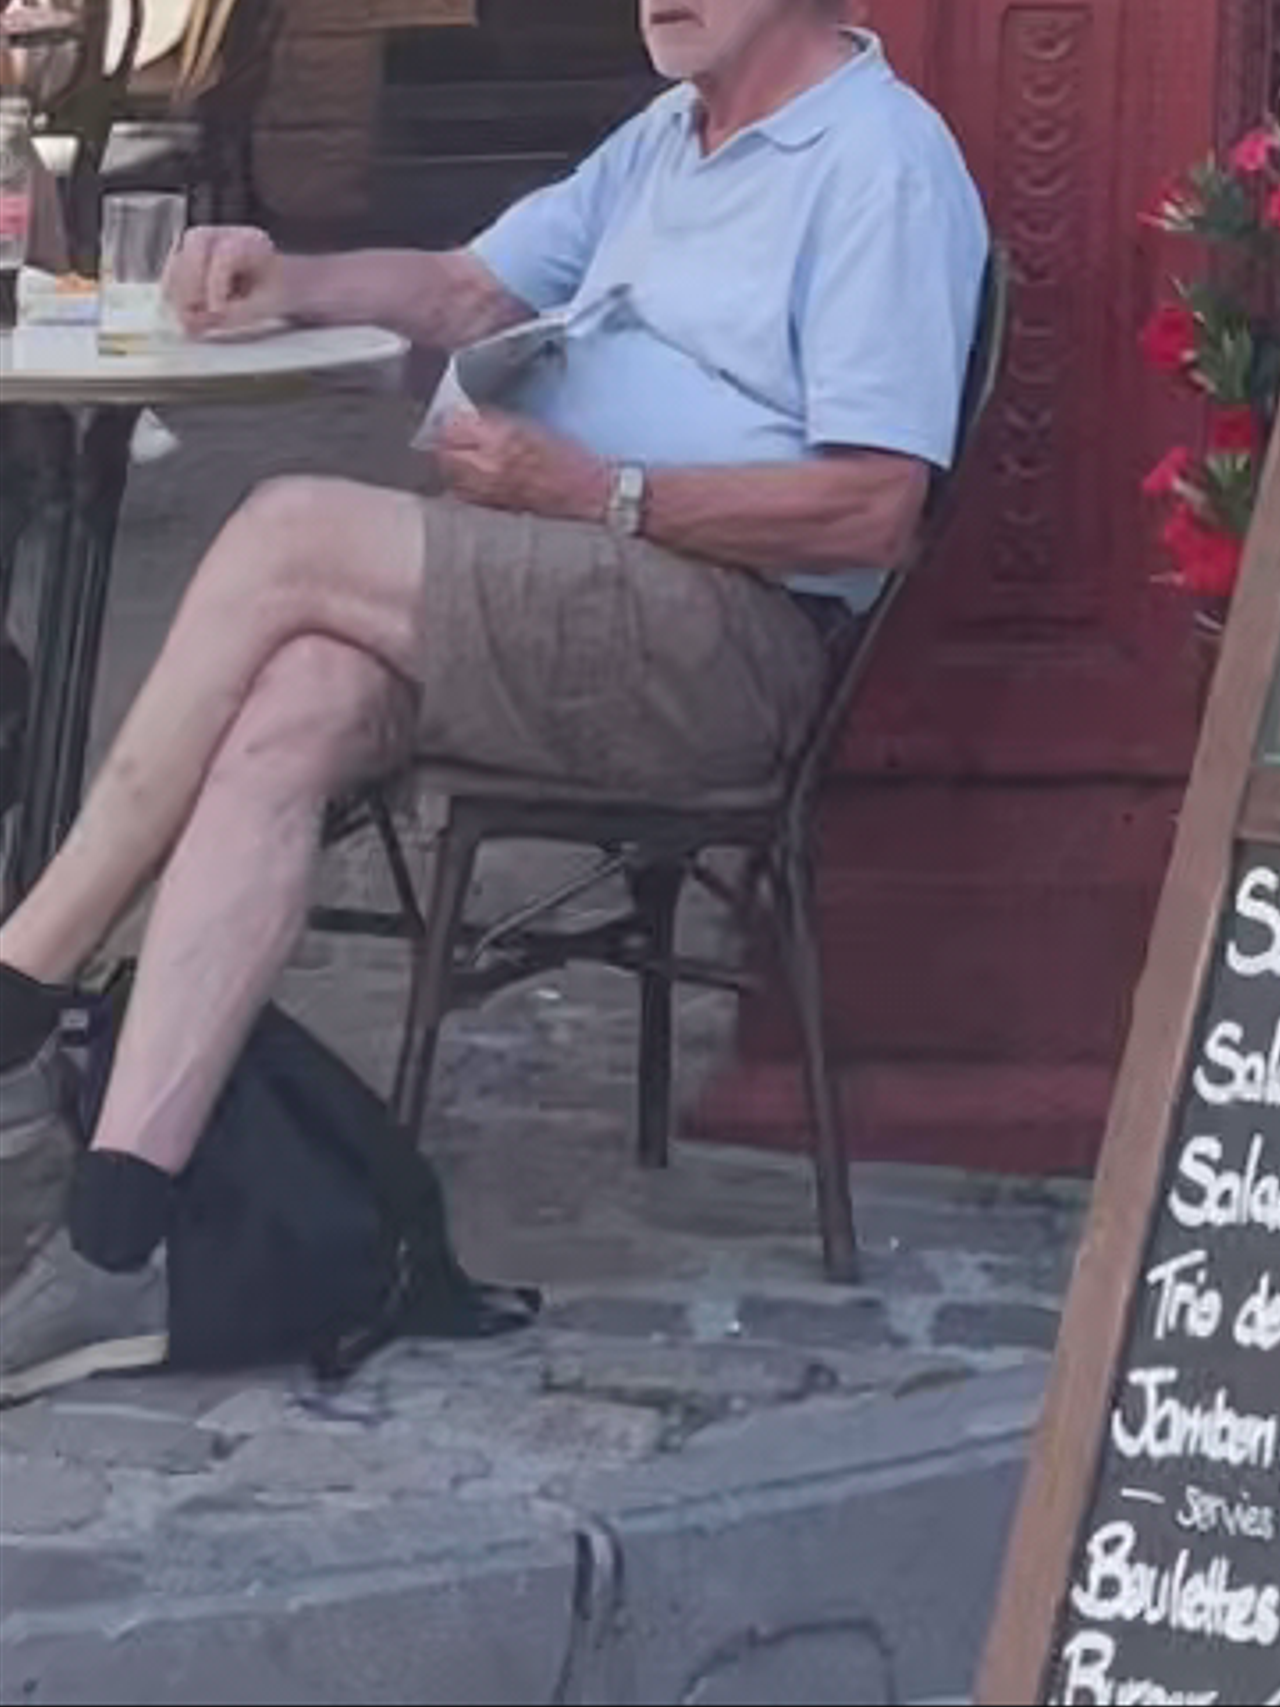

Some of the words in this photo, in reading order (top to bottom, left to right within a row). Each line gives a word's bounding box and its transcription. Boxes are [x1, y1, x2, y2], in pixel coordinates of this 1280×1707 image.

[1147, 1250, 1222, 1339] Trio
[1112, 1367, 1278, 1468] Jambon
[1071, 1520, 1280, 1646] Boulettes
